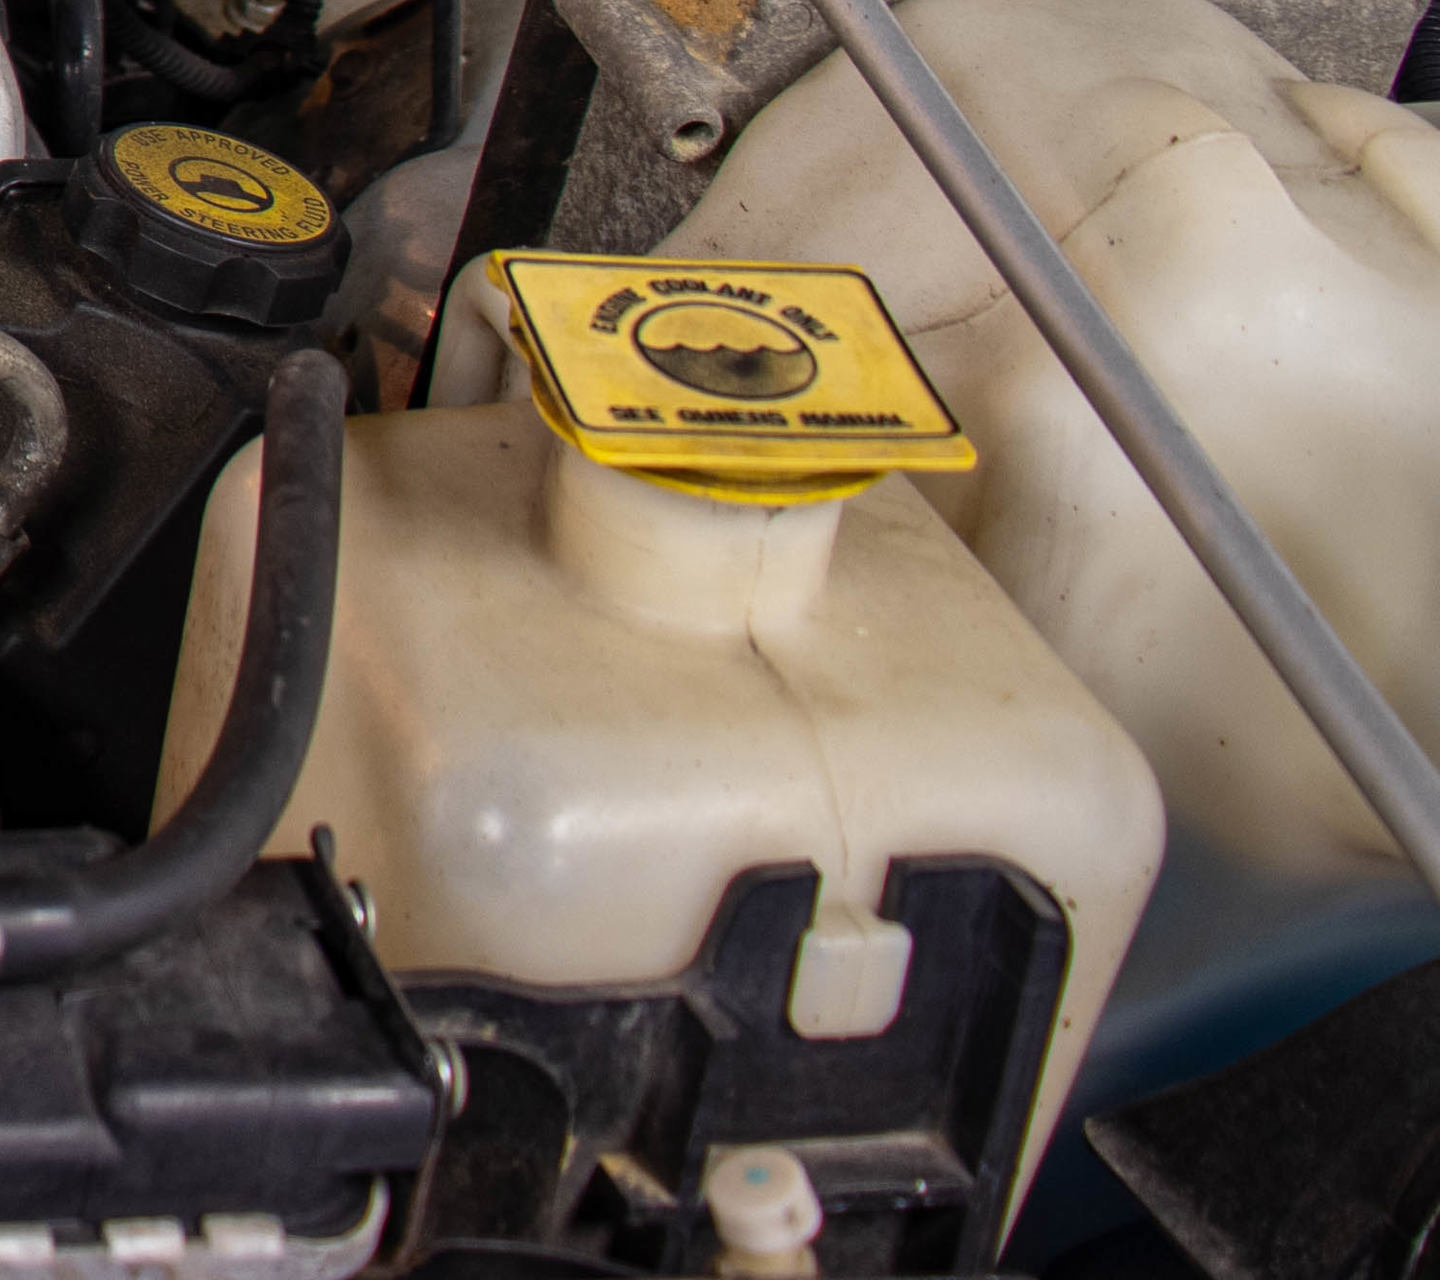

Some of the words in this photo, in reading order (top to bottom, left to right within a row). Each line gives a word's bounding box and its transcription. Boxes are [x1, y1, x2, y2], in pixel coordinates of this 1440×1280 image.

[130, 128, 168, 148] USE
[176, 129, 291, 177] APPROVED
[121, 158, 170, 203] POWER
[179, 206, 300, 241] STEERING
[295, 196, 328, 235] FLUID
[646, 278, 772, 307] COOLANT
[779, 305, 840, 342] ONLY
[608, 404, 665, 425] SEE
[797, 410, 913, 429] MANUAL
